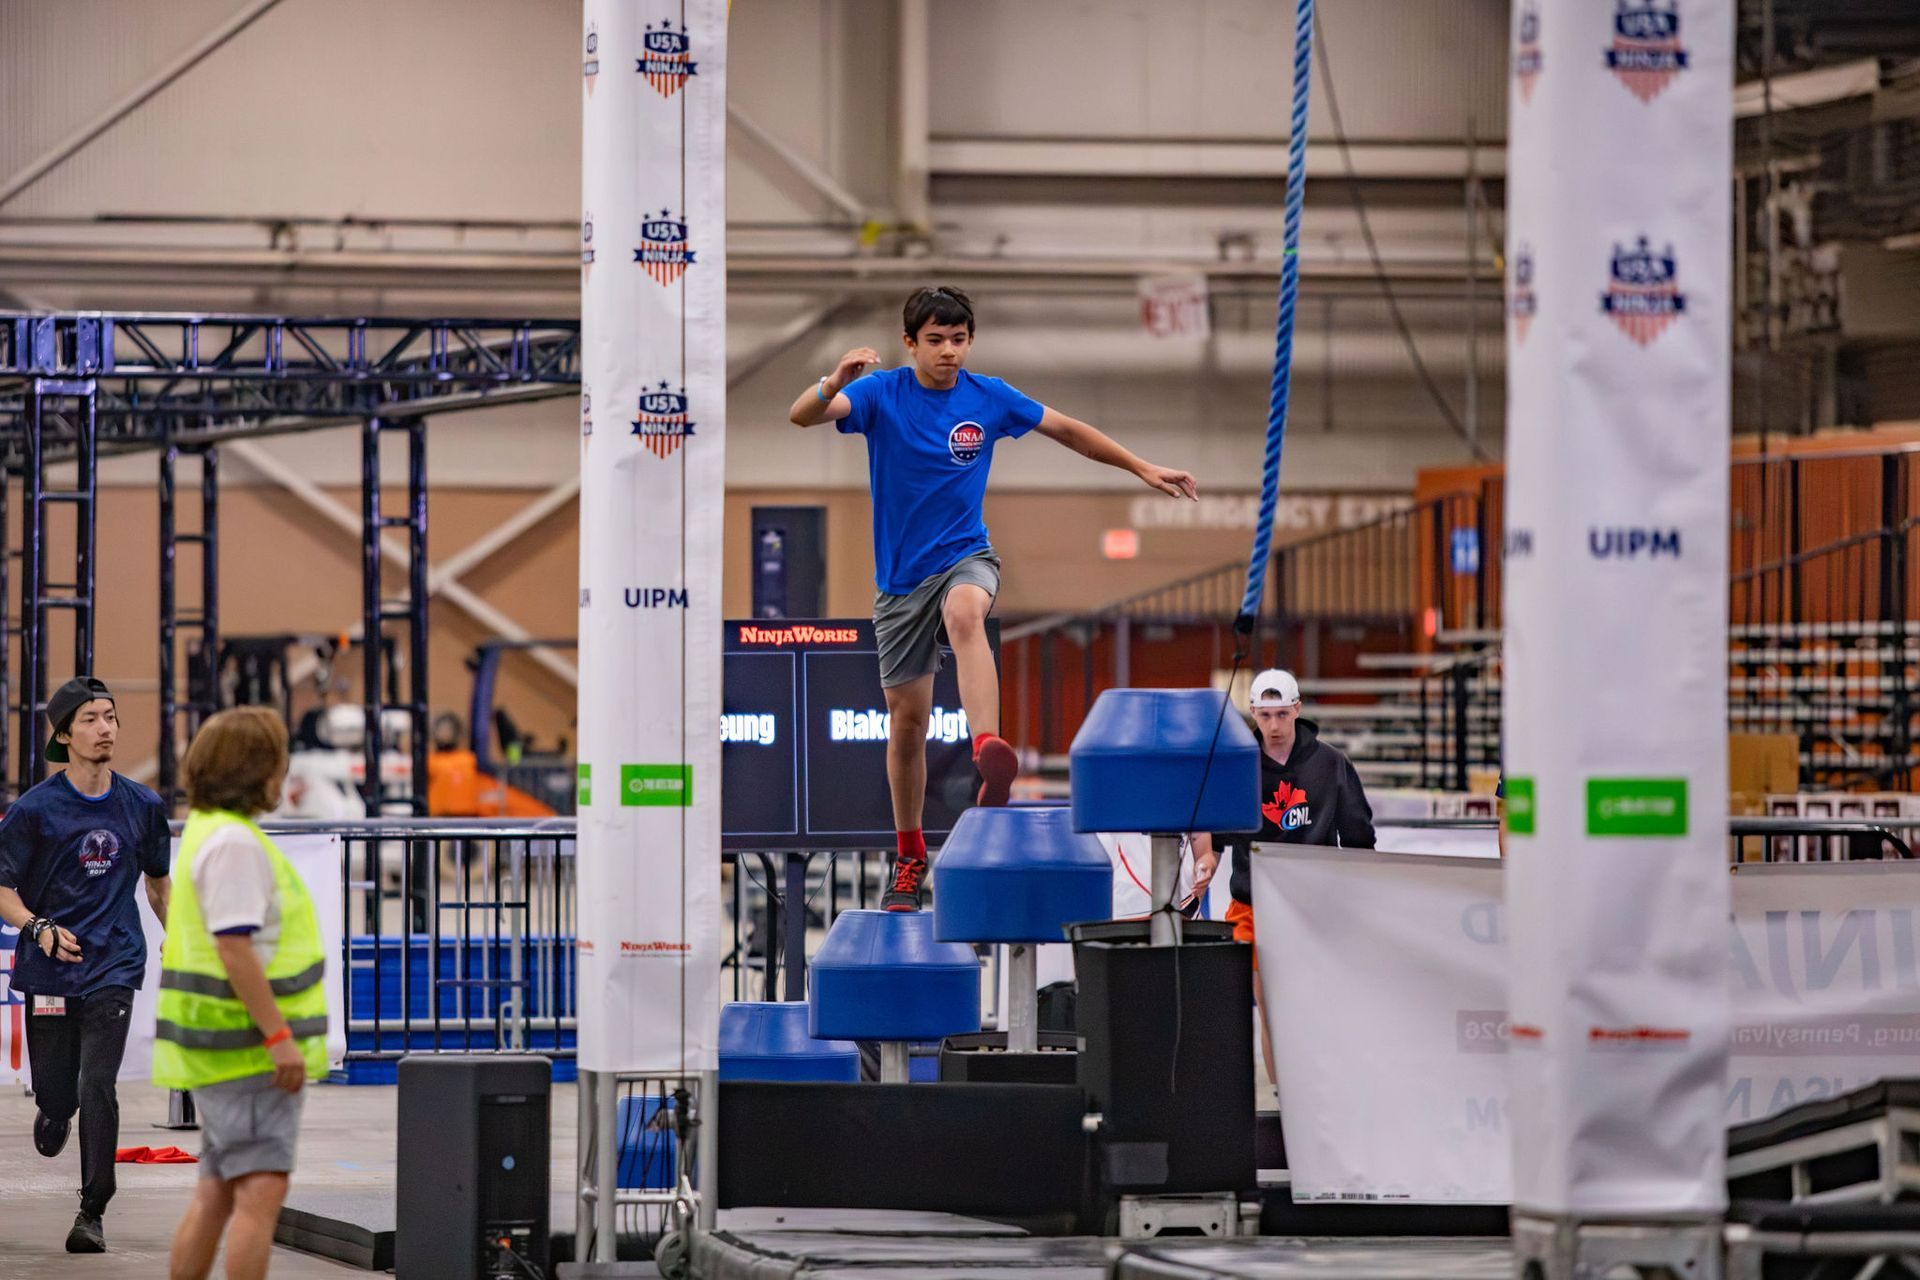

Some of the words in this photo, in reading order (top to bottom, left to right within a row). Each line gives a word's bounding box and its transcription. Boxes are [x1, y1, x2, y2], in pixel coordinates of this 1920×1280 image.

[648, 34, 682, 52] USA
[645, 60, 688, 75] NINJA
[646, 223, 682, 241] USA
[642, 250, 687, 264] NINJA
[644, 395, 681, 413] USA
[640, 422, 684, 435] NINJA
[953, 431, 984, 442] UNAA
[1588, 528, 1681, 558] UIPM
[625, 588, 688, 608] UIPM
[1288, 806, 1312, 827] CNL
